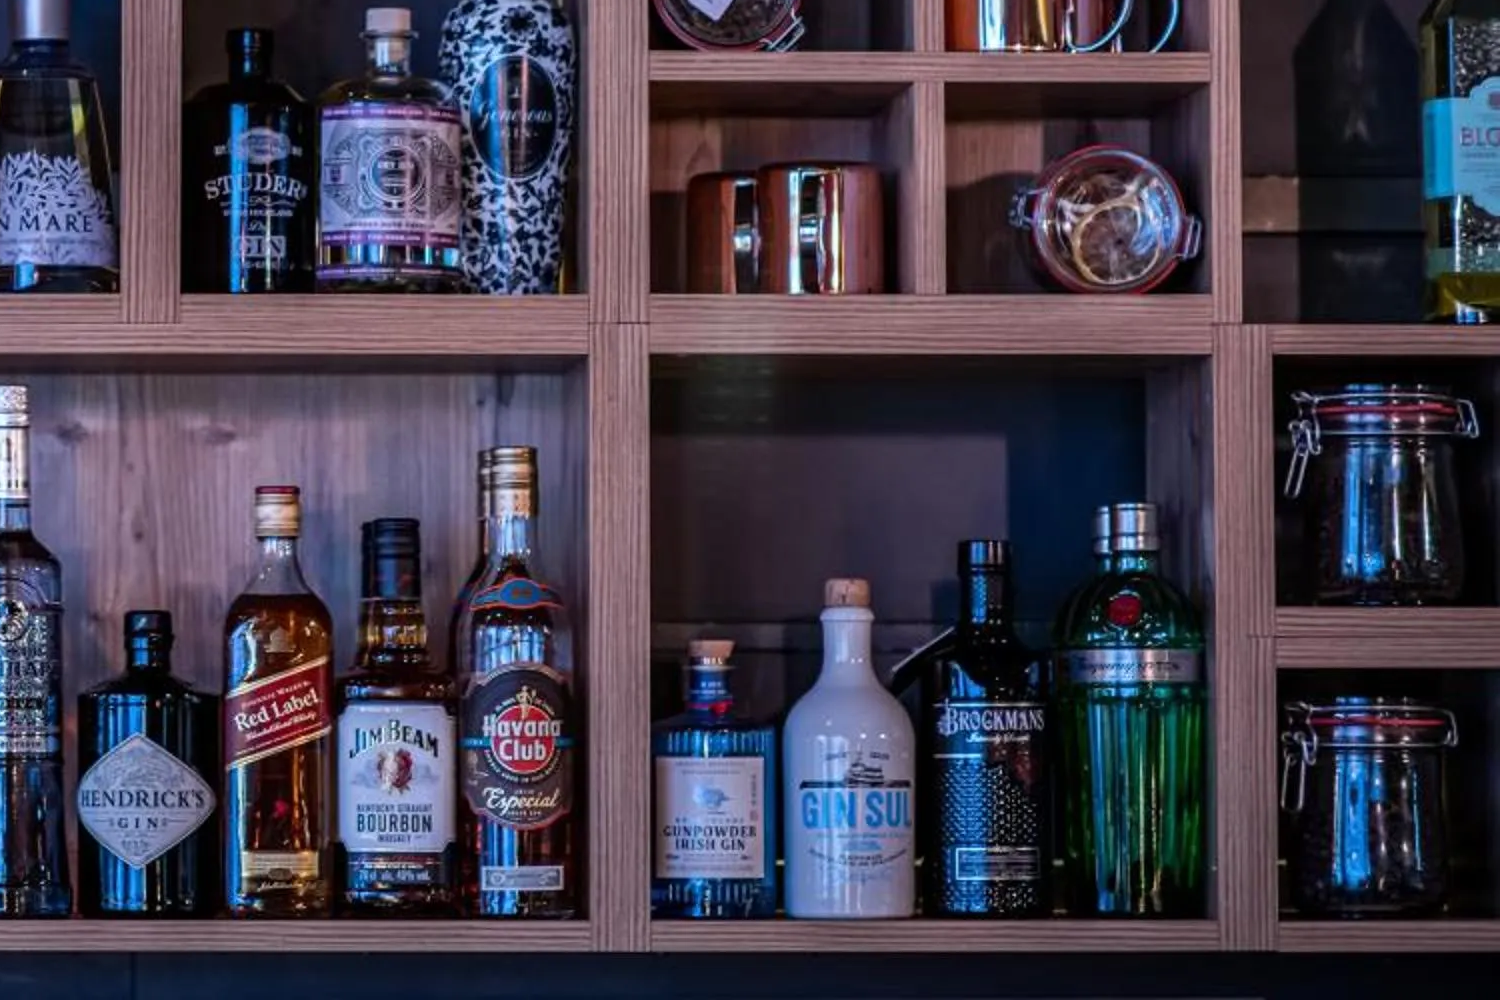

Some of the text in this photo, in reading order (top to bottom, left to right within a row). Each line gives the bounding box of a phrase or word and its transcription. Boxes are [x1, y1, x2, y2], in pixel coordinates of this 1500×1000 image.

[19, 212, 94, 233] MARE
[234, 687, 320, 732] Red Label
[940, 705, 1046, 735] BROCKMANS
[482, 714, 562, 738] Havana
[348, 718, 439, 759] JIM BEAM
[499, 738, 547, 761] Club
[80, 788, 206, 809] HENDRICK'S
[482, 787, 560, 817] Especial
[801, 791, 912, 829] GIN SUL
[116, 817, 159, 829] GIN
[357, 813, 434, 833] BOURBON
[663, 824, 757, 839] GUNPOWDER
[675, 839, 746, 852] IRISH GIN
